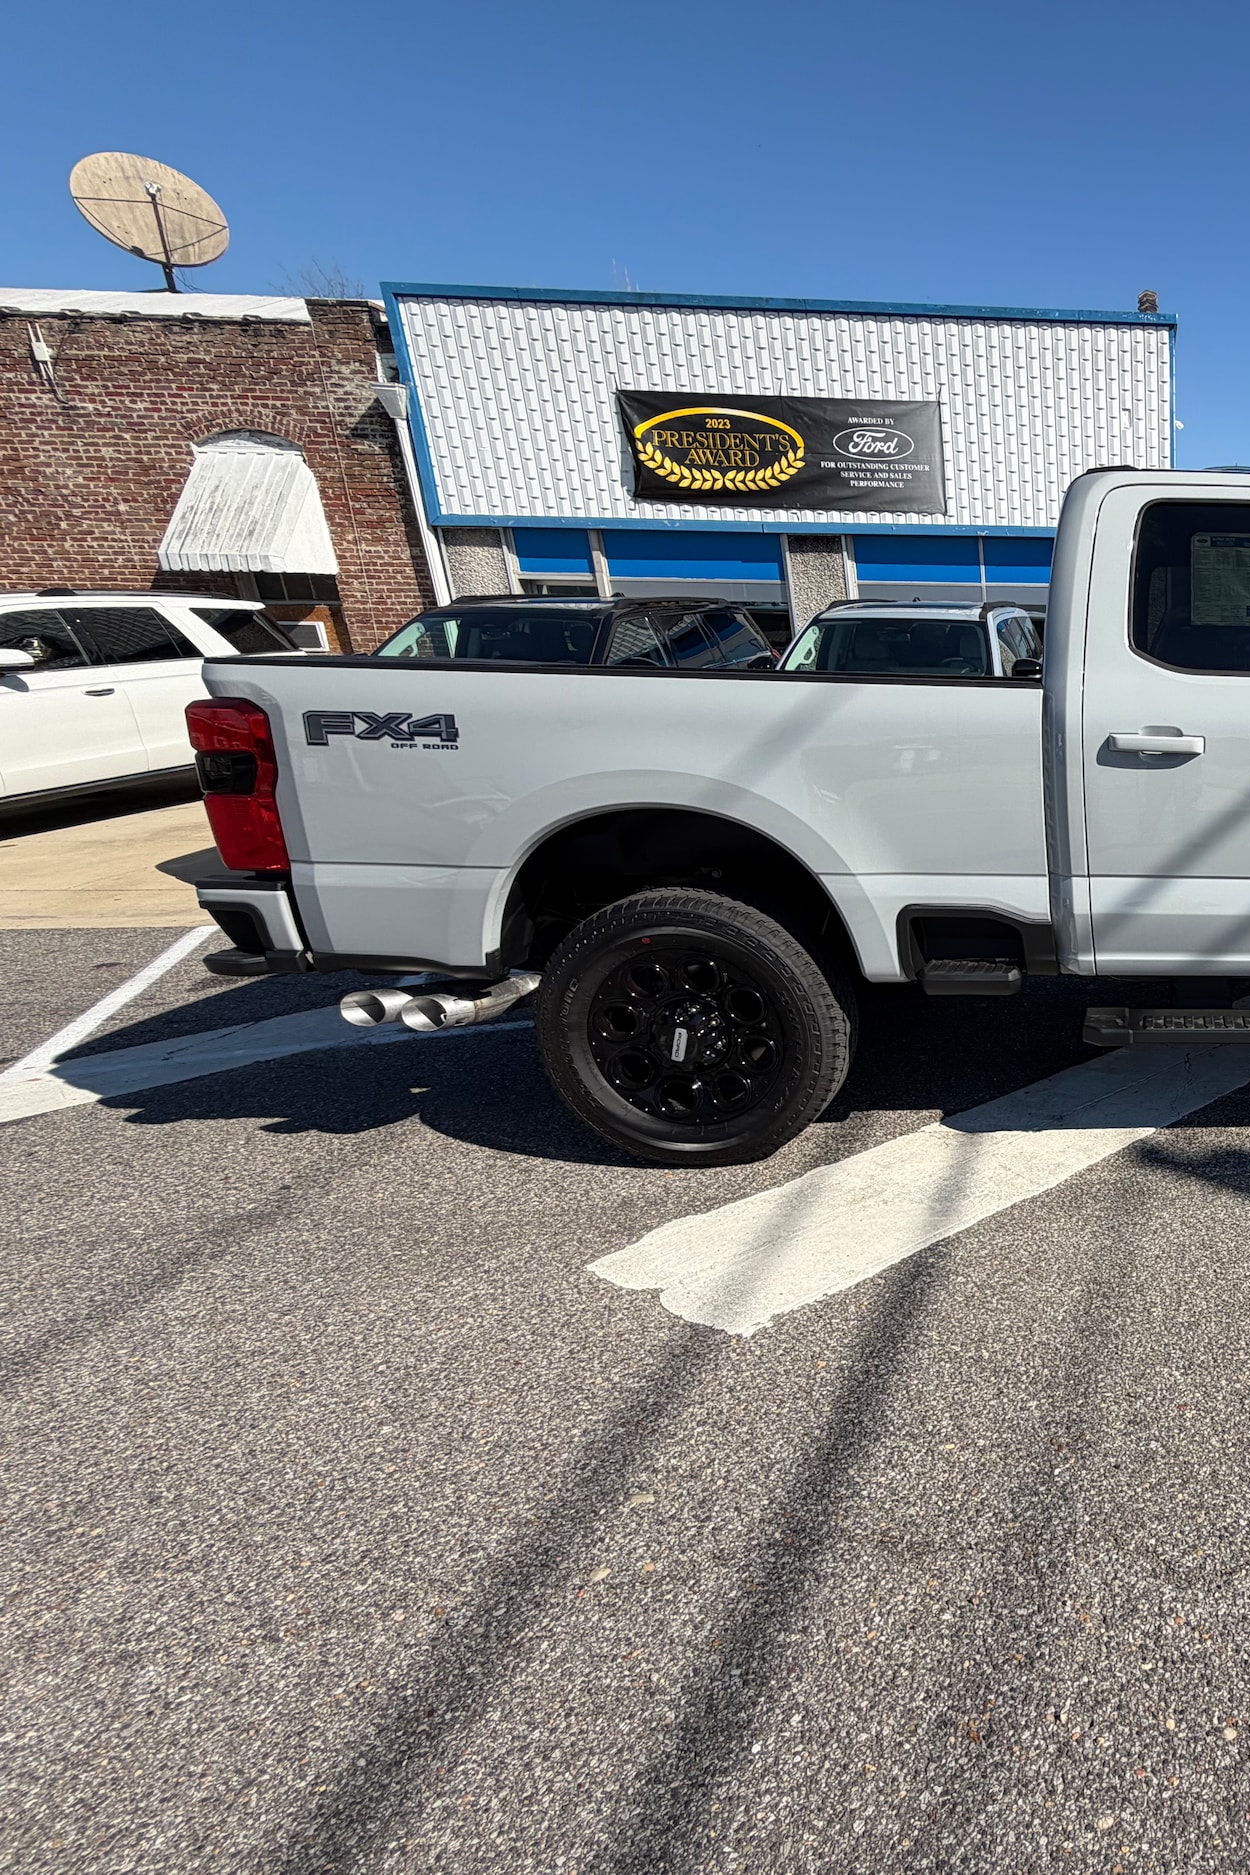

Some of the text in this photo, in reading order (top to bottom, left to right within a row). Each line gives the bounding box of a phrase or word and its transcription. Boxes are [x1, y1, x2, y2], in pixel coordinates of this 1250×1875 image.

[705, 418, 731, 429] 2023
[847, 416, 895, 425] AWARDED BY
[651, 429, 791, 452] PRESIDENT'S
[848, 430, 899, 454] Ford
[684, 448, 760, 467] AWARD
[820, 461, 930, 471] FOR OUTSTANDING CUSTOMER
[840, 471, 872, 479] SERVICE
[889, 472, 912, 480] SALES
[850, 480, 905, 488] PERFORMANCE
[302, 710, 459, 746] FX4
[423, 743, 459, 751] ROAD
